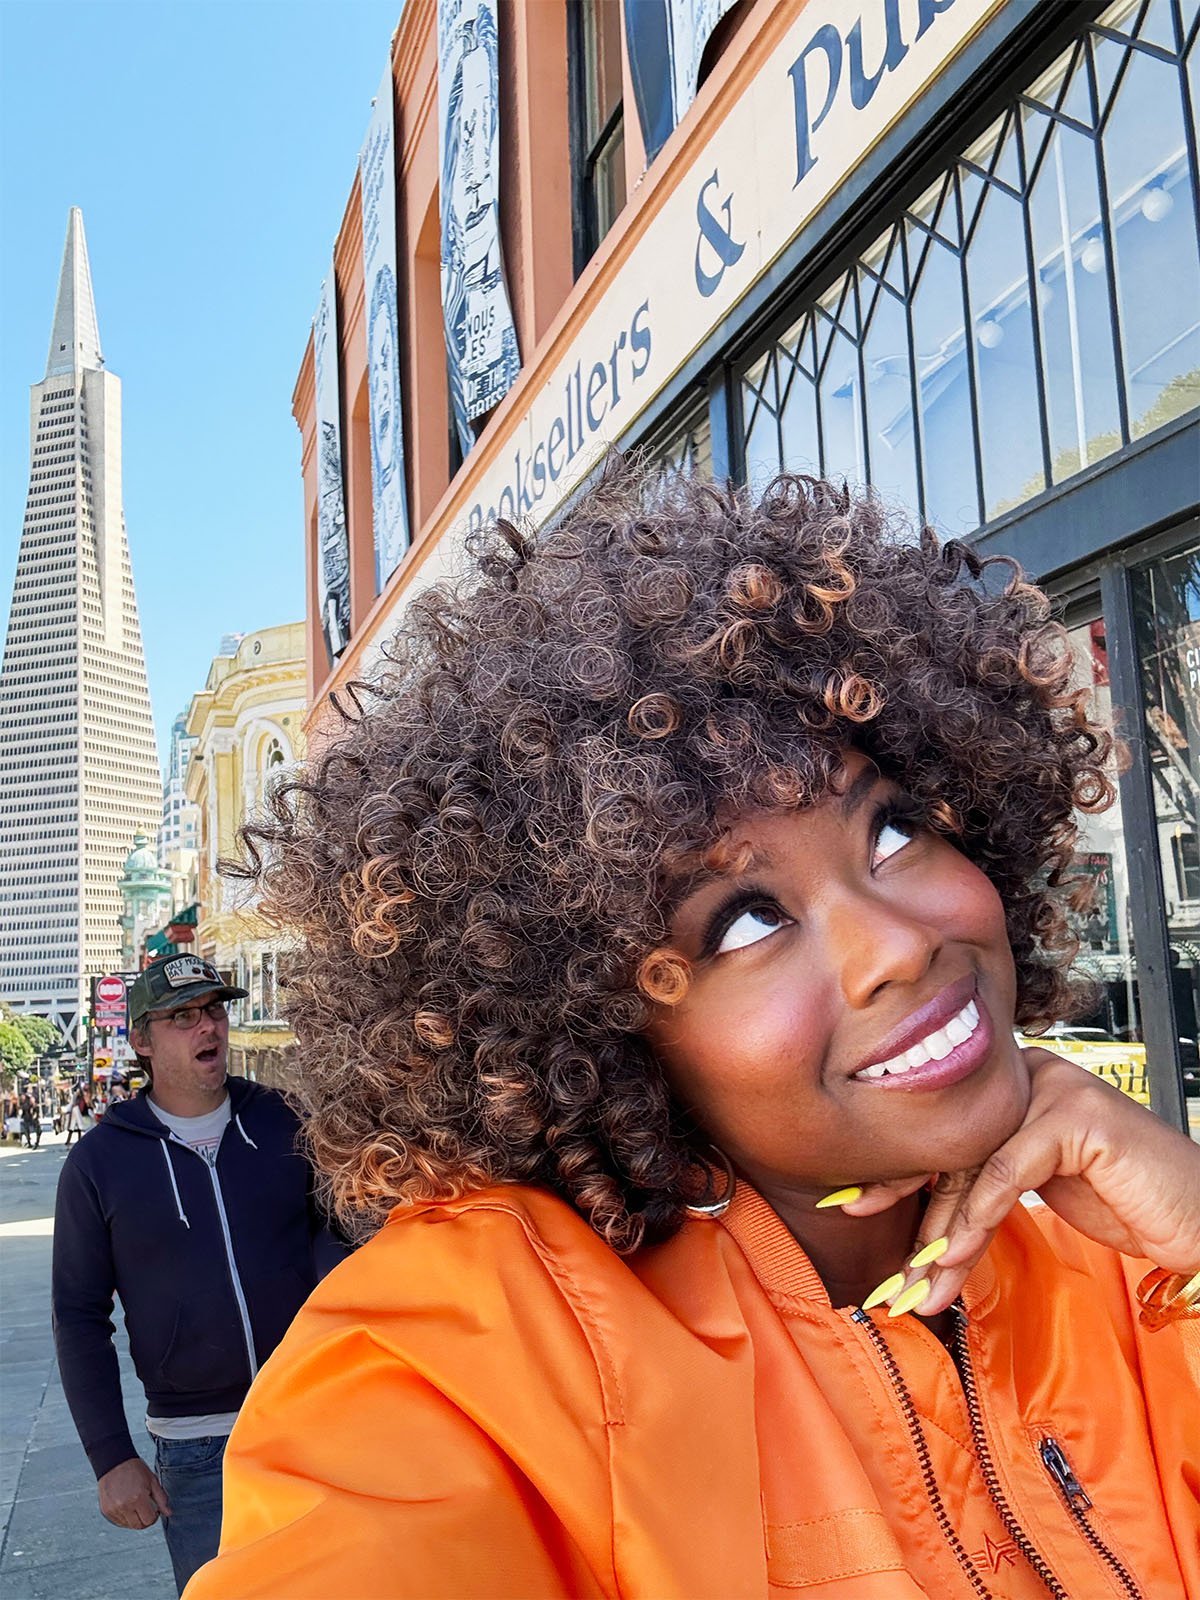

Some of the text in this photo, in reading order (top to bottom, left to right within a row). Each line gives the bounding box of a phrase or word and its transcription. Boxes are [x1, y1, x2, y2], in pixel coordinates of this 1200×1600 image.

[695, 168, 747, 298] &
[787, 0, 956, 192] Pu
[166, 959, 183, 972] HALF
[168, 968, 184, 977] BAY
